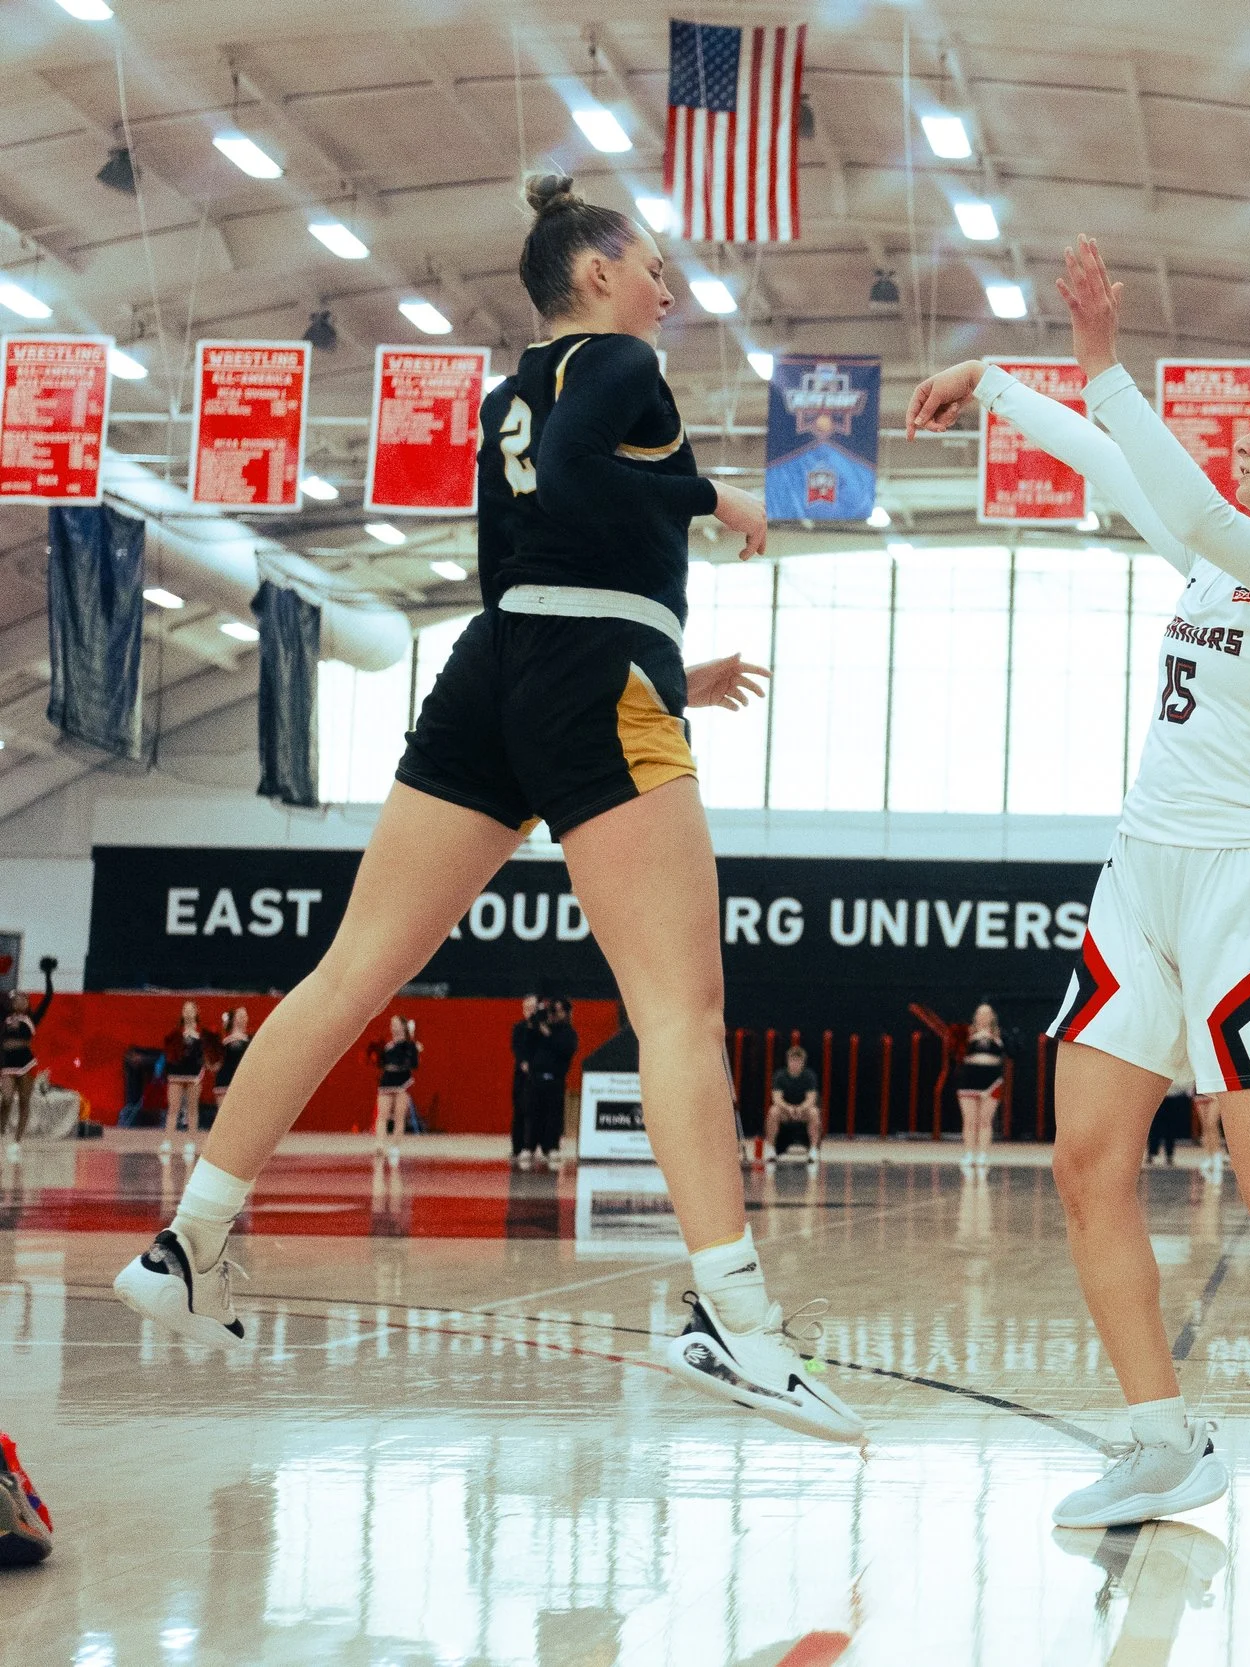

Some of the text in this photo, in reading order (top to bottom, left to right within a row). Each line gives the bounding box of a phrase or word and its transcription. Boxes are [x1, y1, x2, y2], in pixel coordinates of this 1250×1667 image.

[14, 346, 102, 361] WRESTLING
[208, 352, 298, 368] WRESTLING
[389, 357, 476, 373] WRESTLING
[499, 395, 537, 497] 2
[1159, 654, 1197, 725] 15
[166, 888, 322, 936] EAST
[830, 898, 1089, 950] UNIVERS
